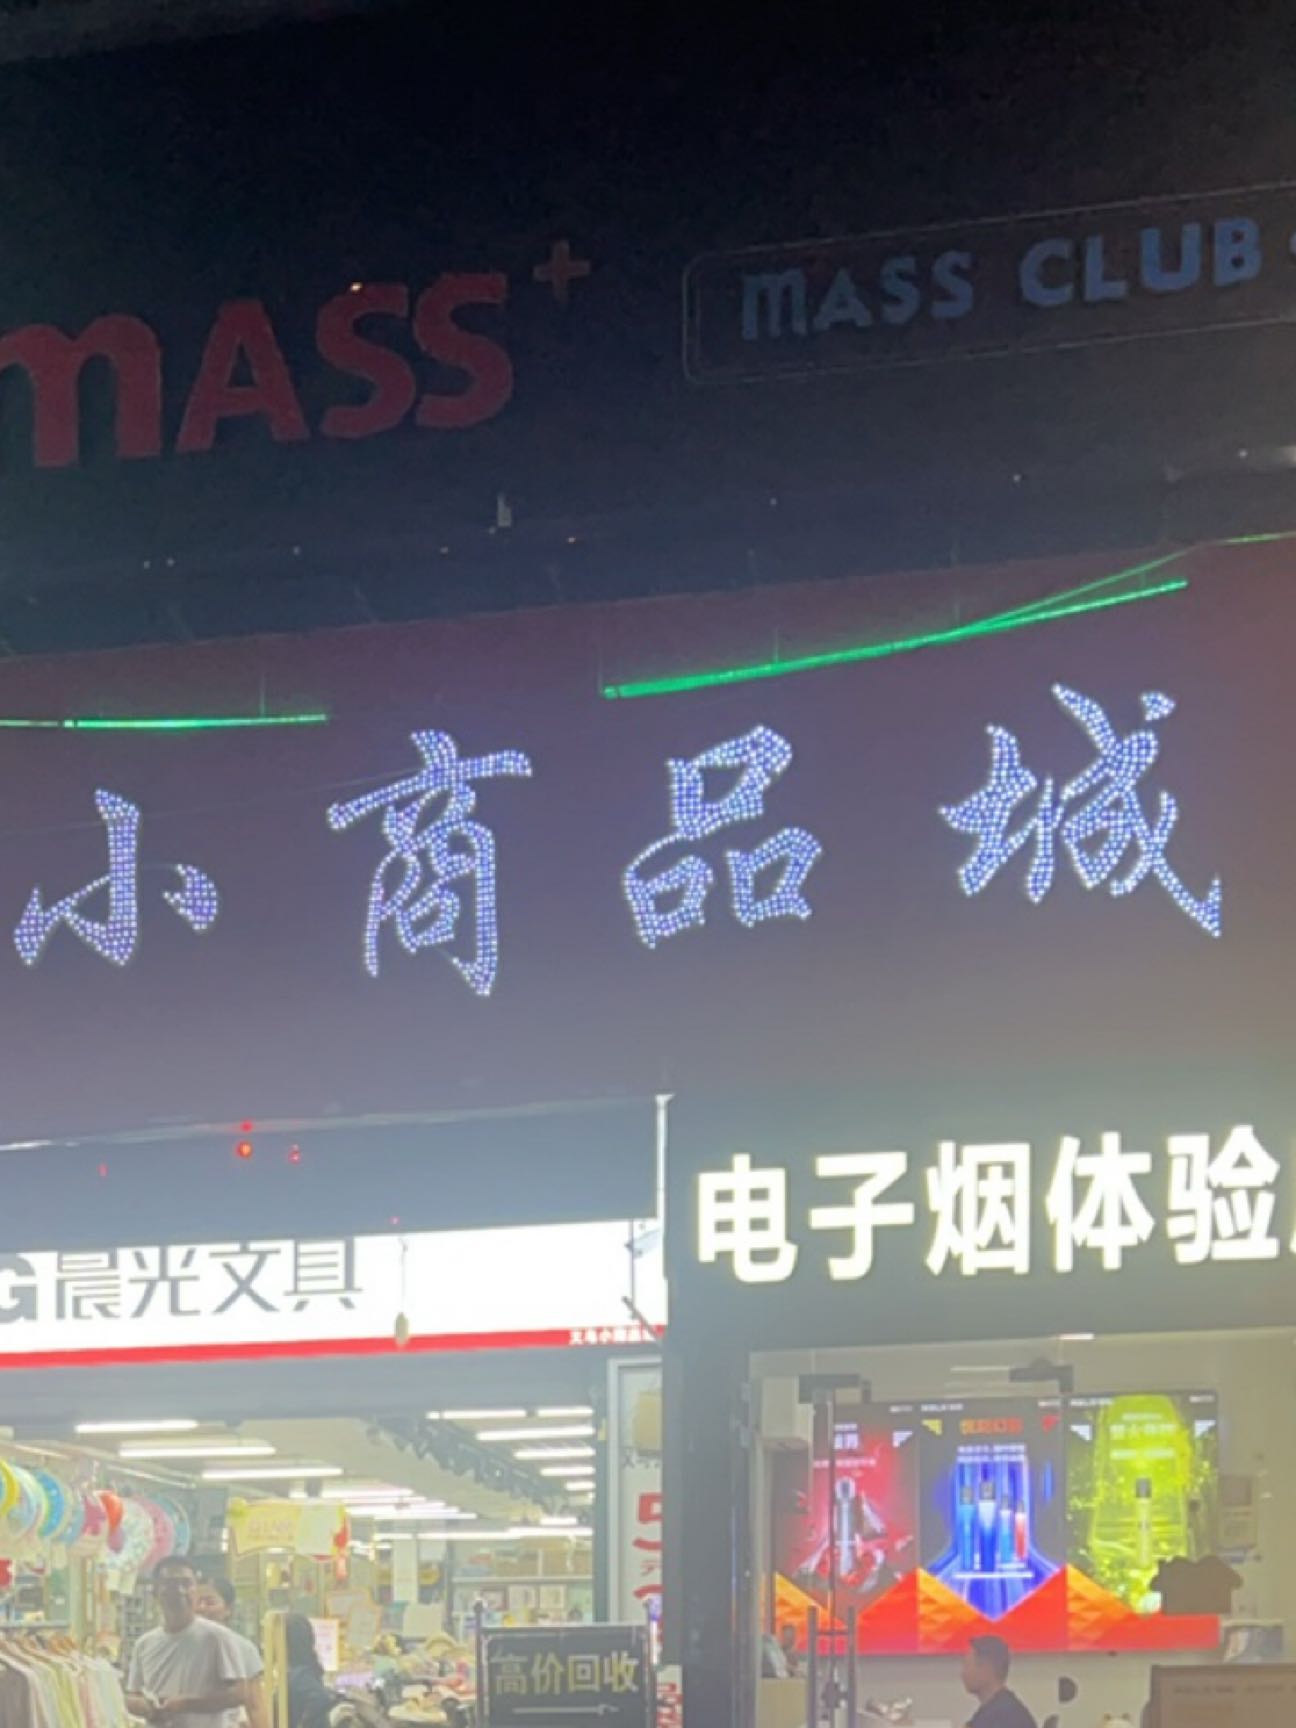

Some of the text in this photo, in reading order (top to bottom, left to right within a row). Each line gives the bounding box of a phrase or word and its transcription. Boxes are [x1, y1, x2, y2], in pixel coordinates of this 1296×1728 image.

[1018, 217, 1263, 309] CLUB
[696, 1124, 1296, 1284] 电子烟体验
[55, 1239, 363, 1320] 晨光文具
[489, 1651, 640, 1696] 高价回收
